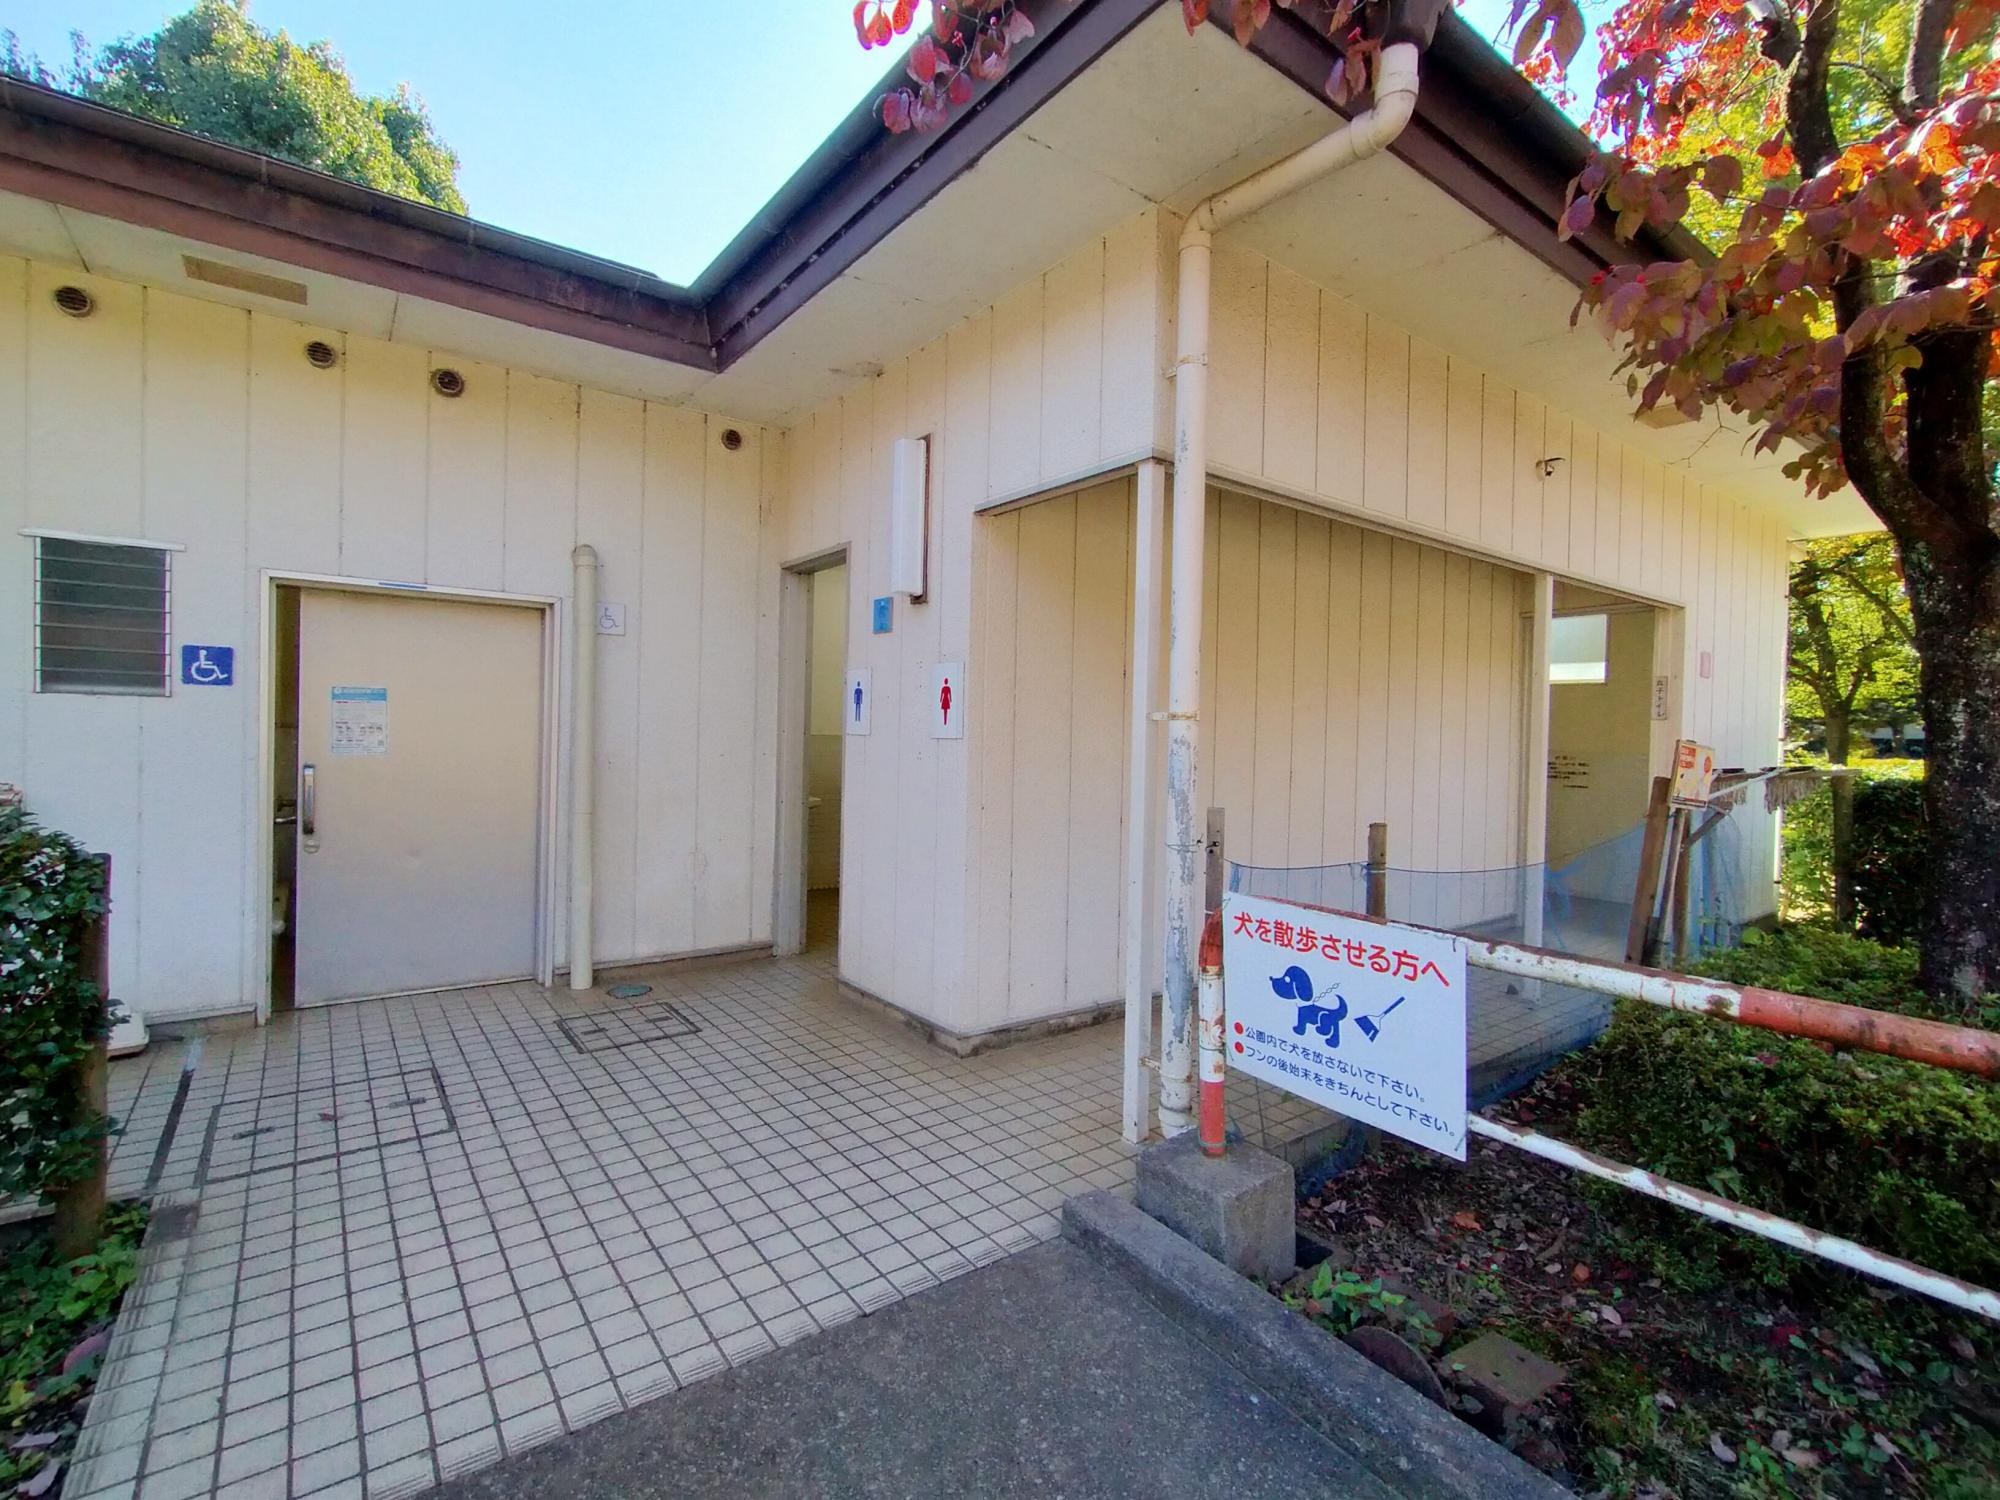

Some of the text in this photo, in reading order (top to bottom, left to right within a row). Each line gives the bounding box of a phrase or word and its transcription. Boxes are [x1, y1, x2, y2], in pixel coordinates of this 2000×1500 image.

[1233, 911, 1450, 987] 犬を散歩させる方へ
[1245, 1026, 1425, 1103] 公園内で犬を放さないで下さい。
[1246, 1045, 1455, 1137] フンの後始末をきちんとして下さい。
